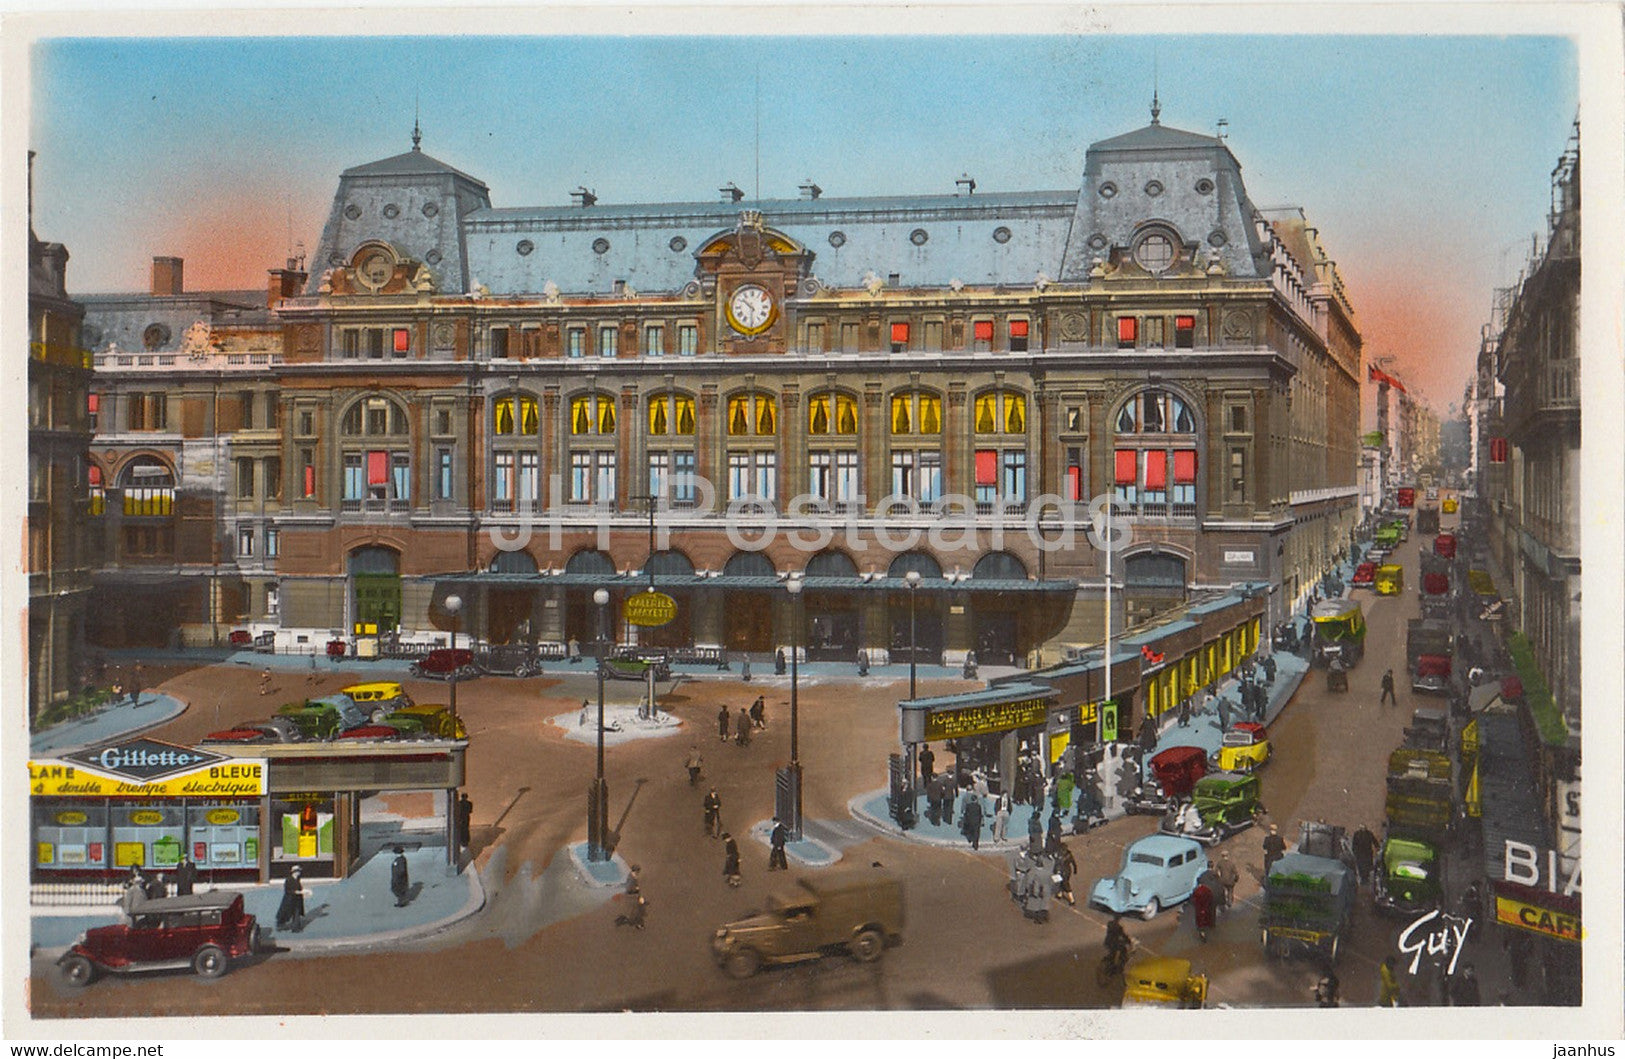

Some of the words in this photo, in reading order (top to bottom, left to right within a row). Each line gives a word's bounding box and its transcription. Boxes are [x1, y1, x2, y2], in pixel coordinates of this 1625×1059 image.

[101, 748, 189, 769] Gillette
[29, 767, 75, 779] LAME
[210, 766, 262, 778] BLEUE
[57, 782, 101, 793] double
[116, 782, 167, 796] trempe
[182, 781, 257, 796] électrique
